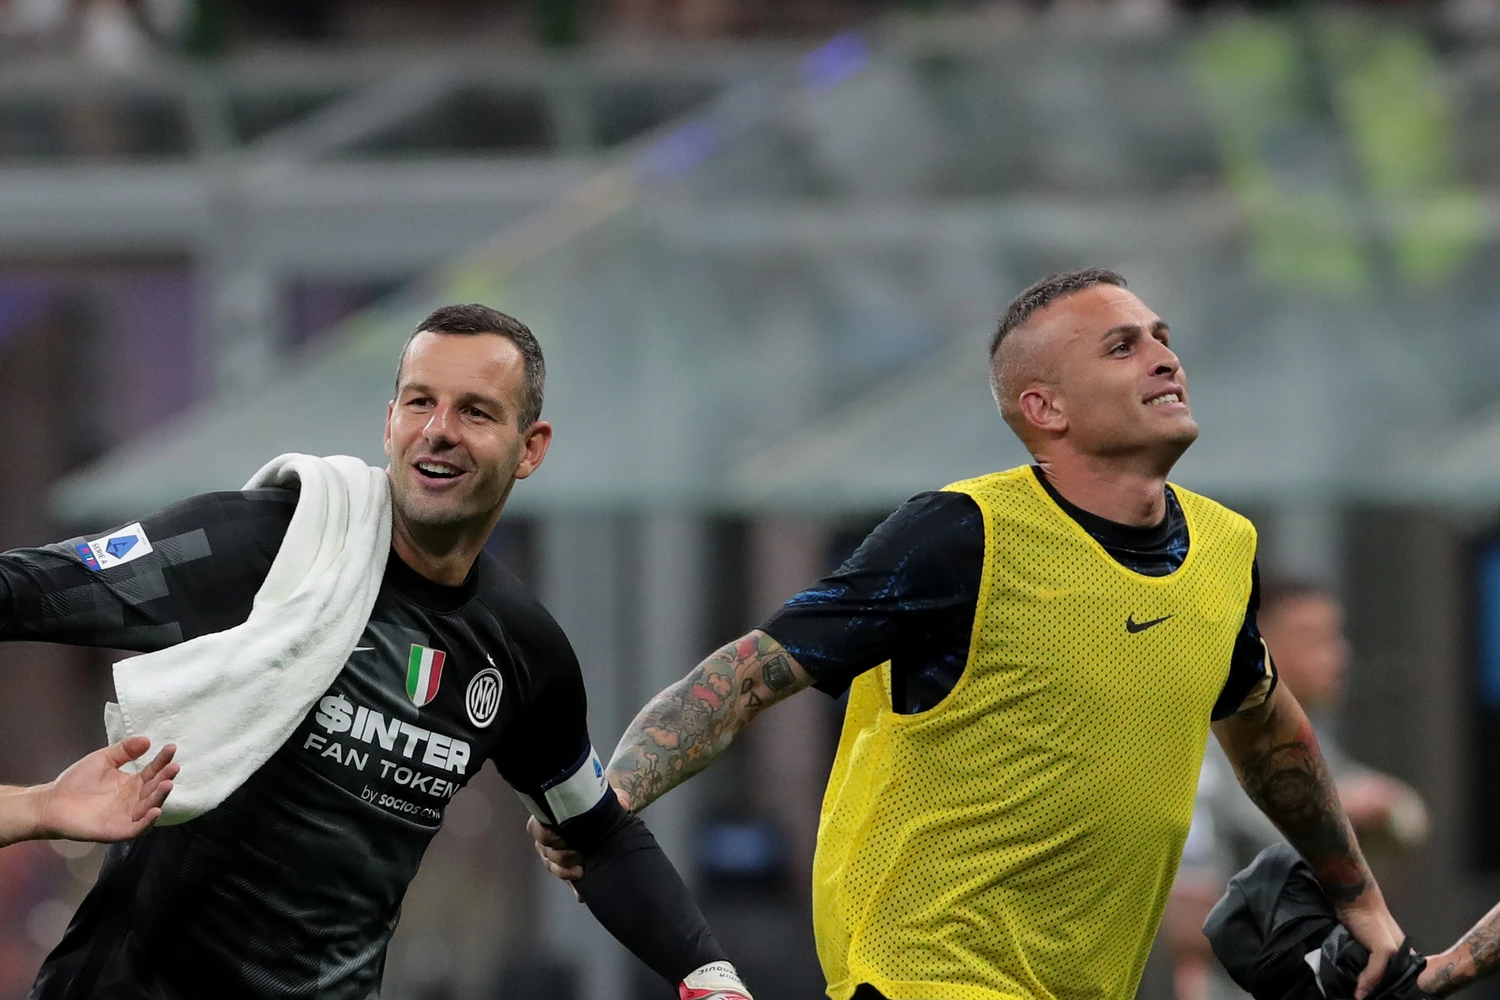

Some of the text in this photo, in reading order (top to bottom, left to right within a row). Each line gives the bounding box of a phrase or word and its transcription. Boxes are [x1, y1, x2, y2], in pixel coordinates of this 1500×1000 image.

[303, 733, 460, 799] FAN TOKEN
[315, 692, 471, 775] $INTER
[361, 785, 378, 804] by
